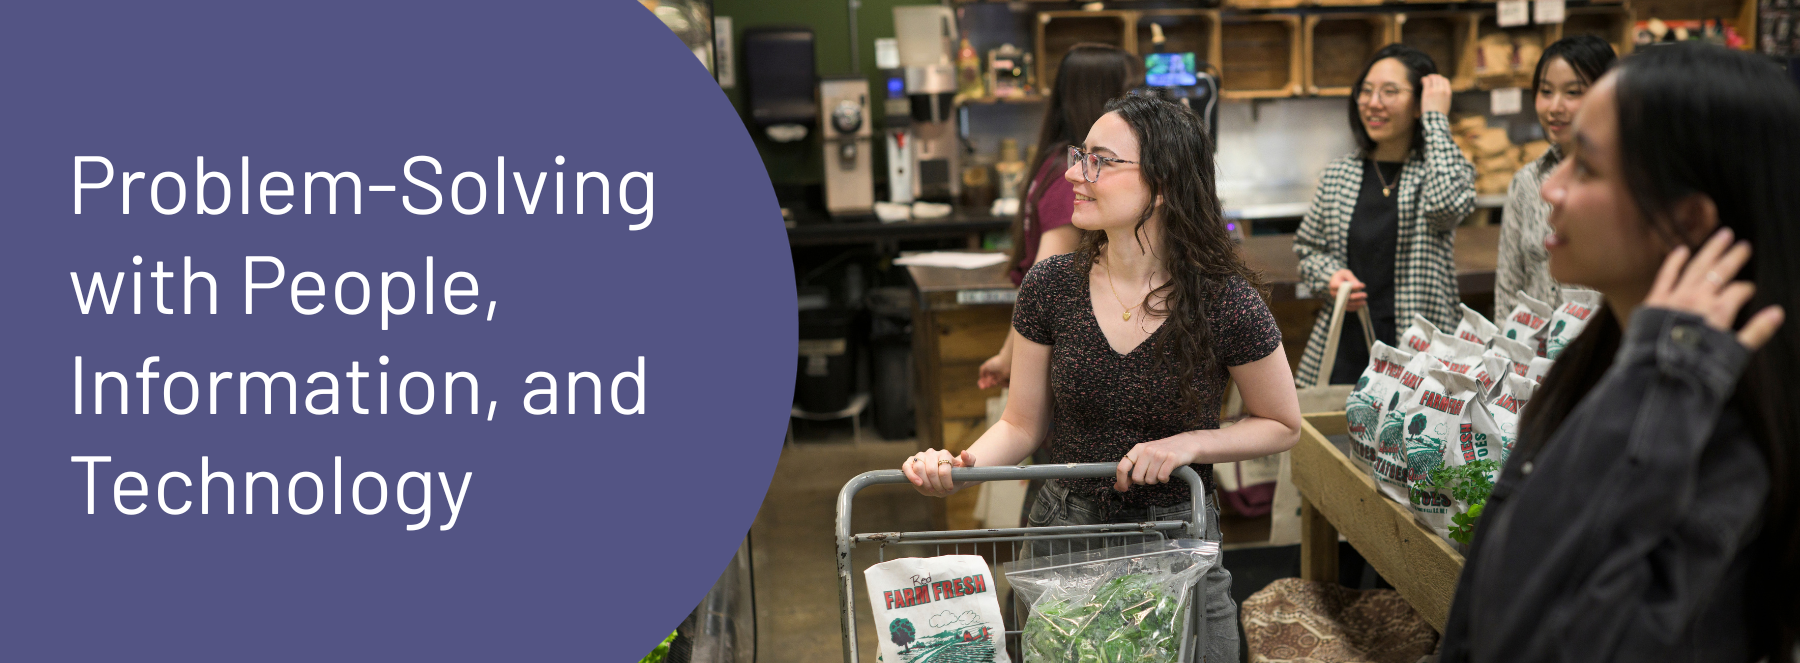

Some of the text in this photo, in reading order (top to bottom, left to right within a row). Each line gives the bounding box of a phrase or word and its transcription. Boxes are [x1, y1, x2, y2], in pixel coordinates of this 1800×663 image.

[1419, 389, 1449, 413] FARM
[1491, 393, 1518, 415] ARM
[1460, 423, 1476, 466] RESH
[910, 572, 932, 587] Red
[883, 574, 987, 610] FARM FRESH
